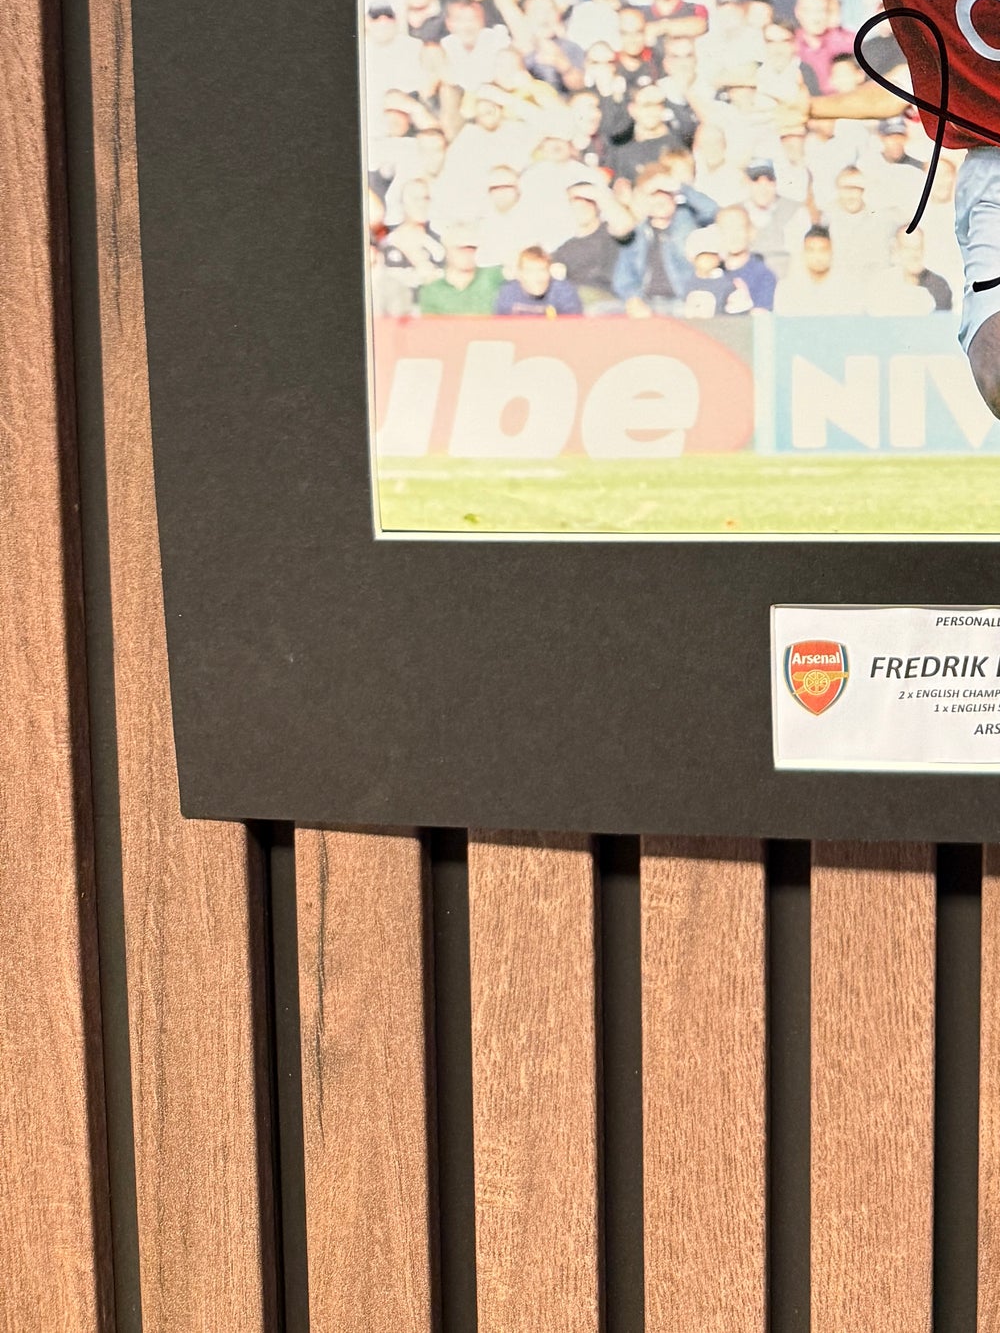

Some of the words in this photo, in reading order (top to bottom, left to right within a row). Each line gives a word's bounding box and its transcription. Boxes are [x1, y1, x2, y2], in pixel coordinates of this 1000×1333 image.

[791, 652, 842, 665] Arsenal
[870, 655, 990, 679] FREDRIK
[898, 690, 905, 700] 2
[916, 689, 960, 699] ENGLISH
[934, 703, 940, 713] 1
[951, 703, 996, 713] ENGLISH
